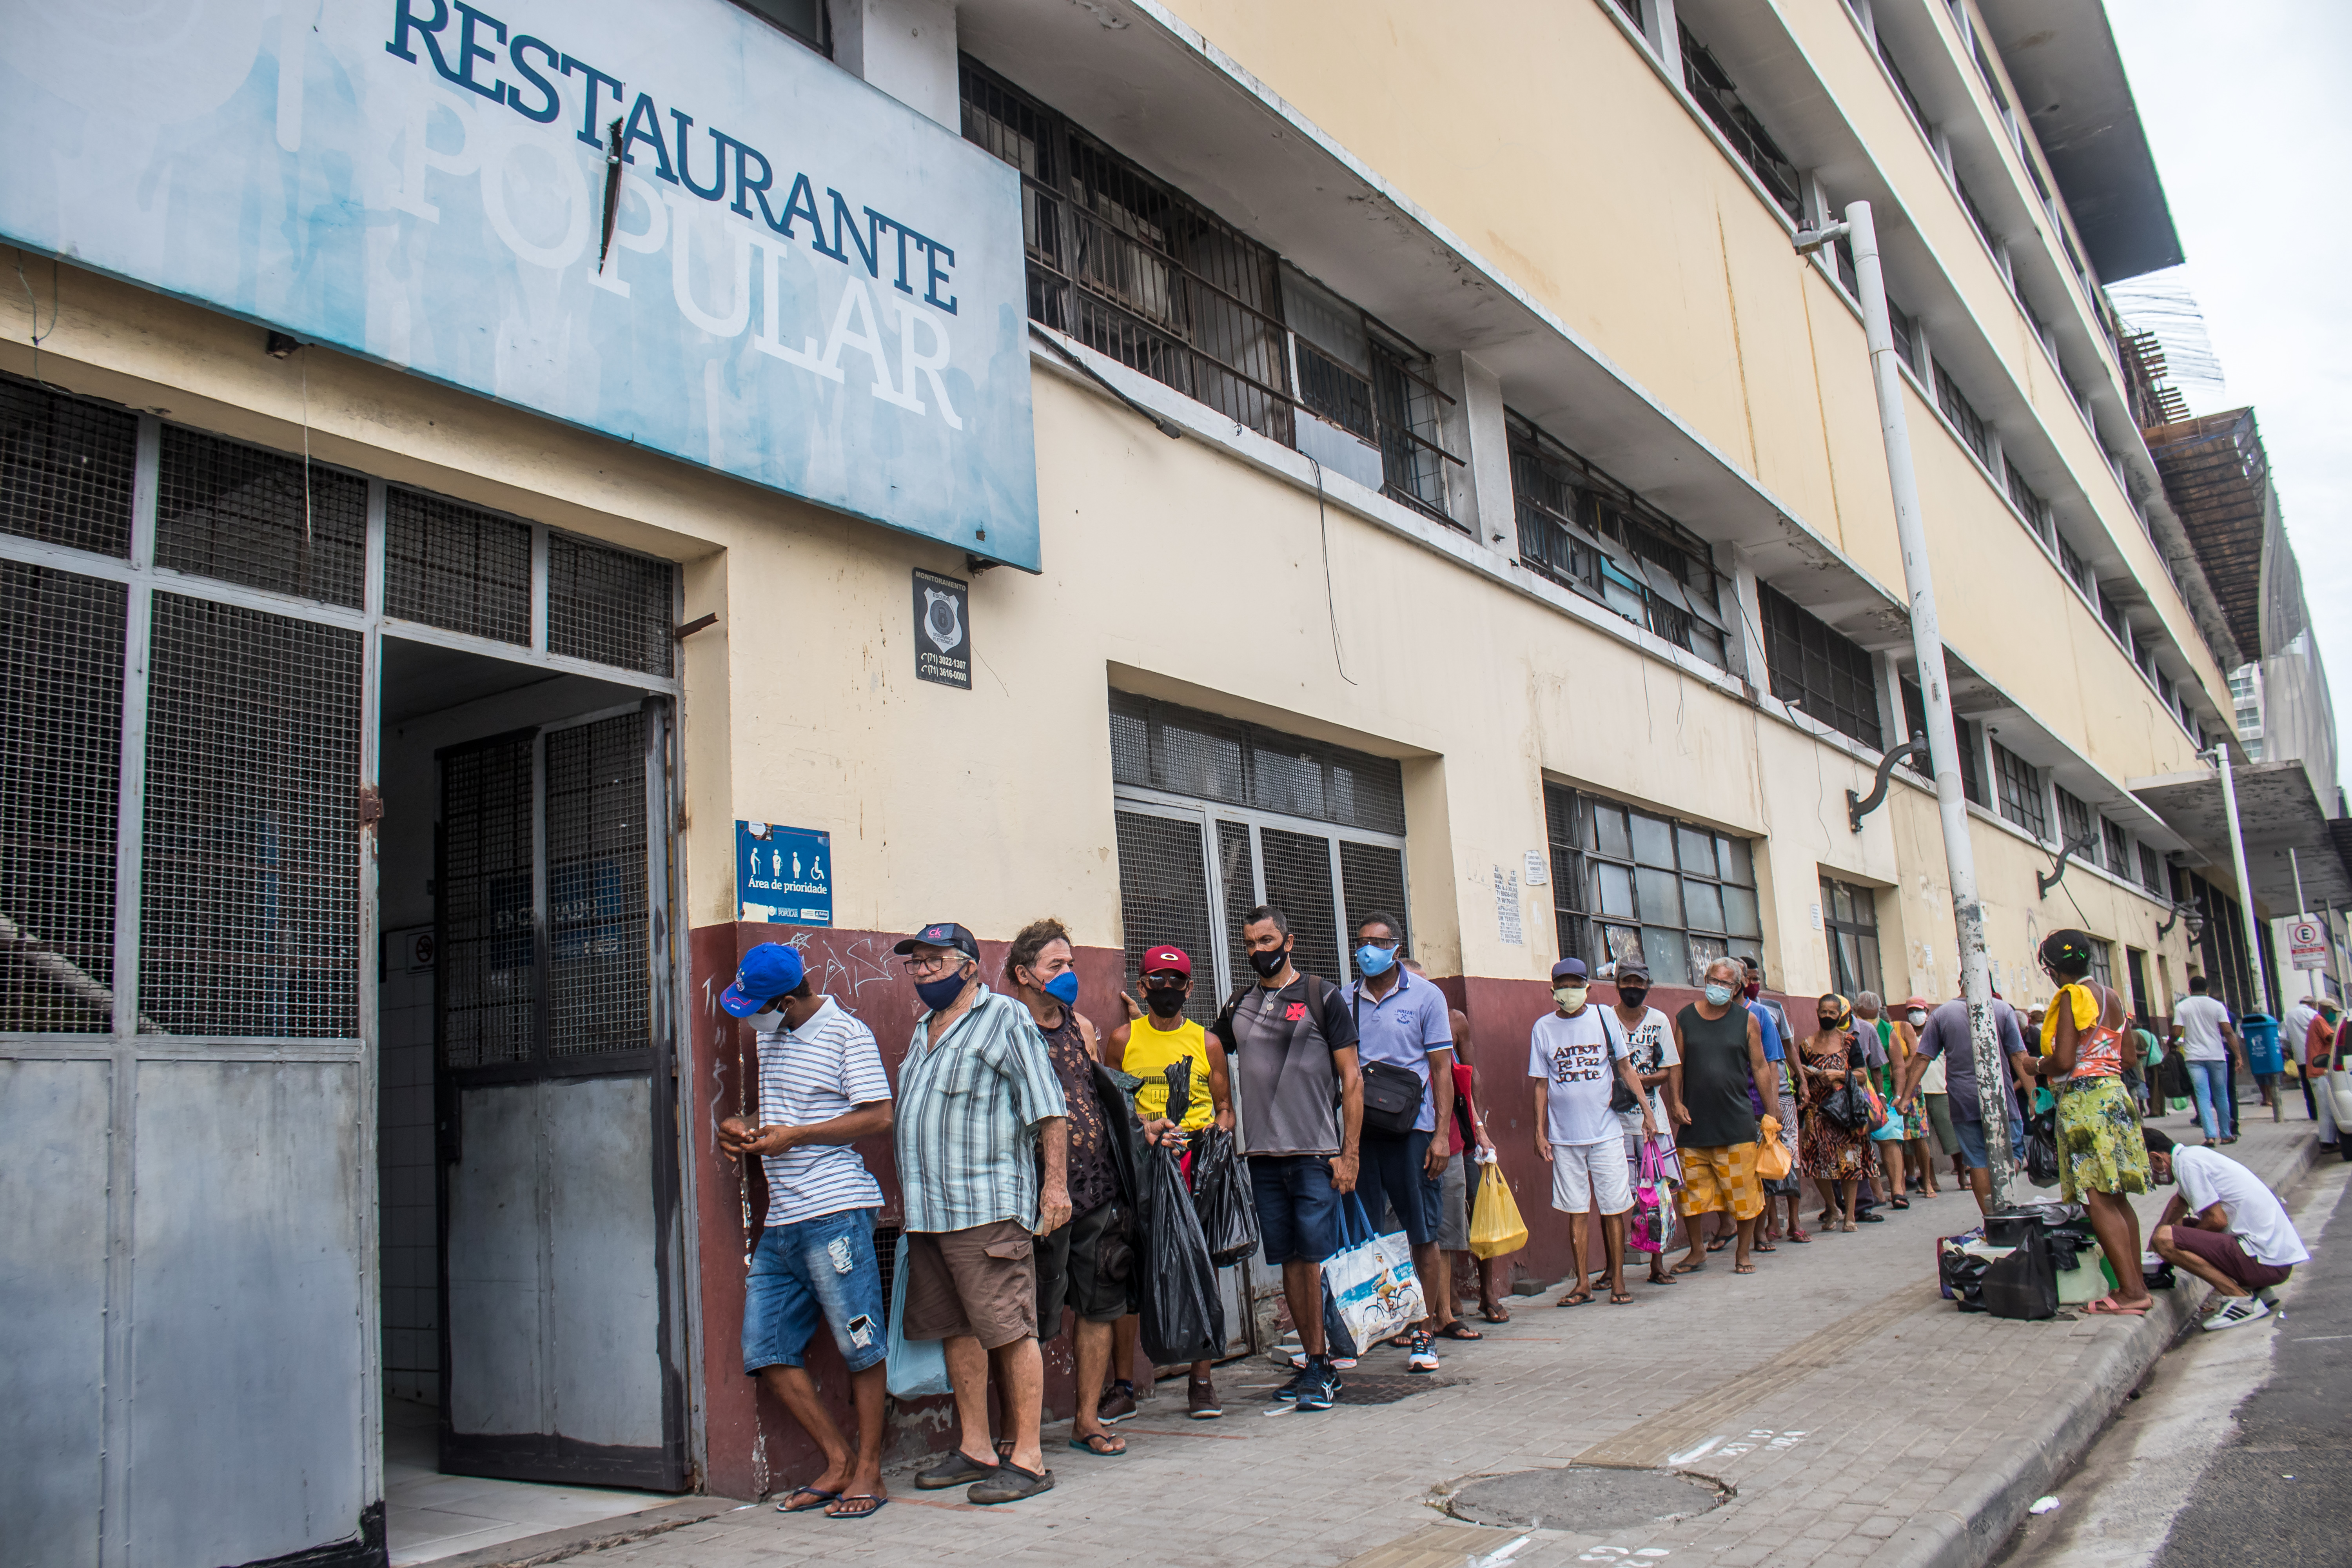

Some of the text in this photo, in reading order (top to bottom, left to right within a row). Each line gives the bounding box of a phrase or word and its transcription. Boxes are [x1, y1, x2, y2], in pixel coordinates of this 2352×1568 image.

[386, 0, 958, 316] RESTAURANTE
[386, 82, 963, 430] POPULAR
[915, 571, 966, 591] MONITORAMENTO
[933, 593, 950, 602] ESCUDO
[927, 653, 966, 670] (71) 3022-1307
[928, 664, 967, 682] (71) 3616-0000
[748, 875, 828, 894] Área de prioridade
[929, 927, 942, 936] ck
[2301, 929, 2310, 940] E
[1575, 1056, 1599, 1067] Paz
